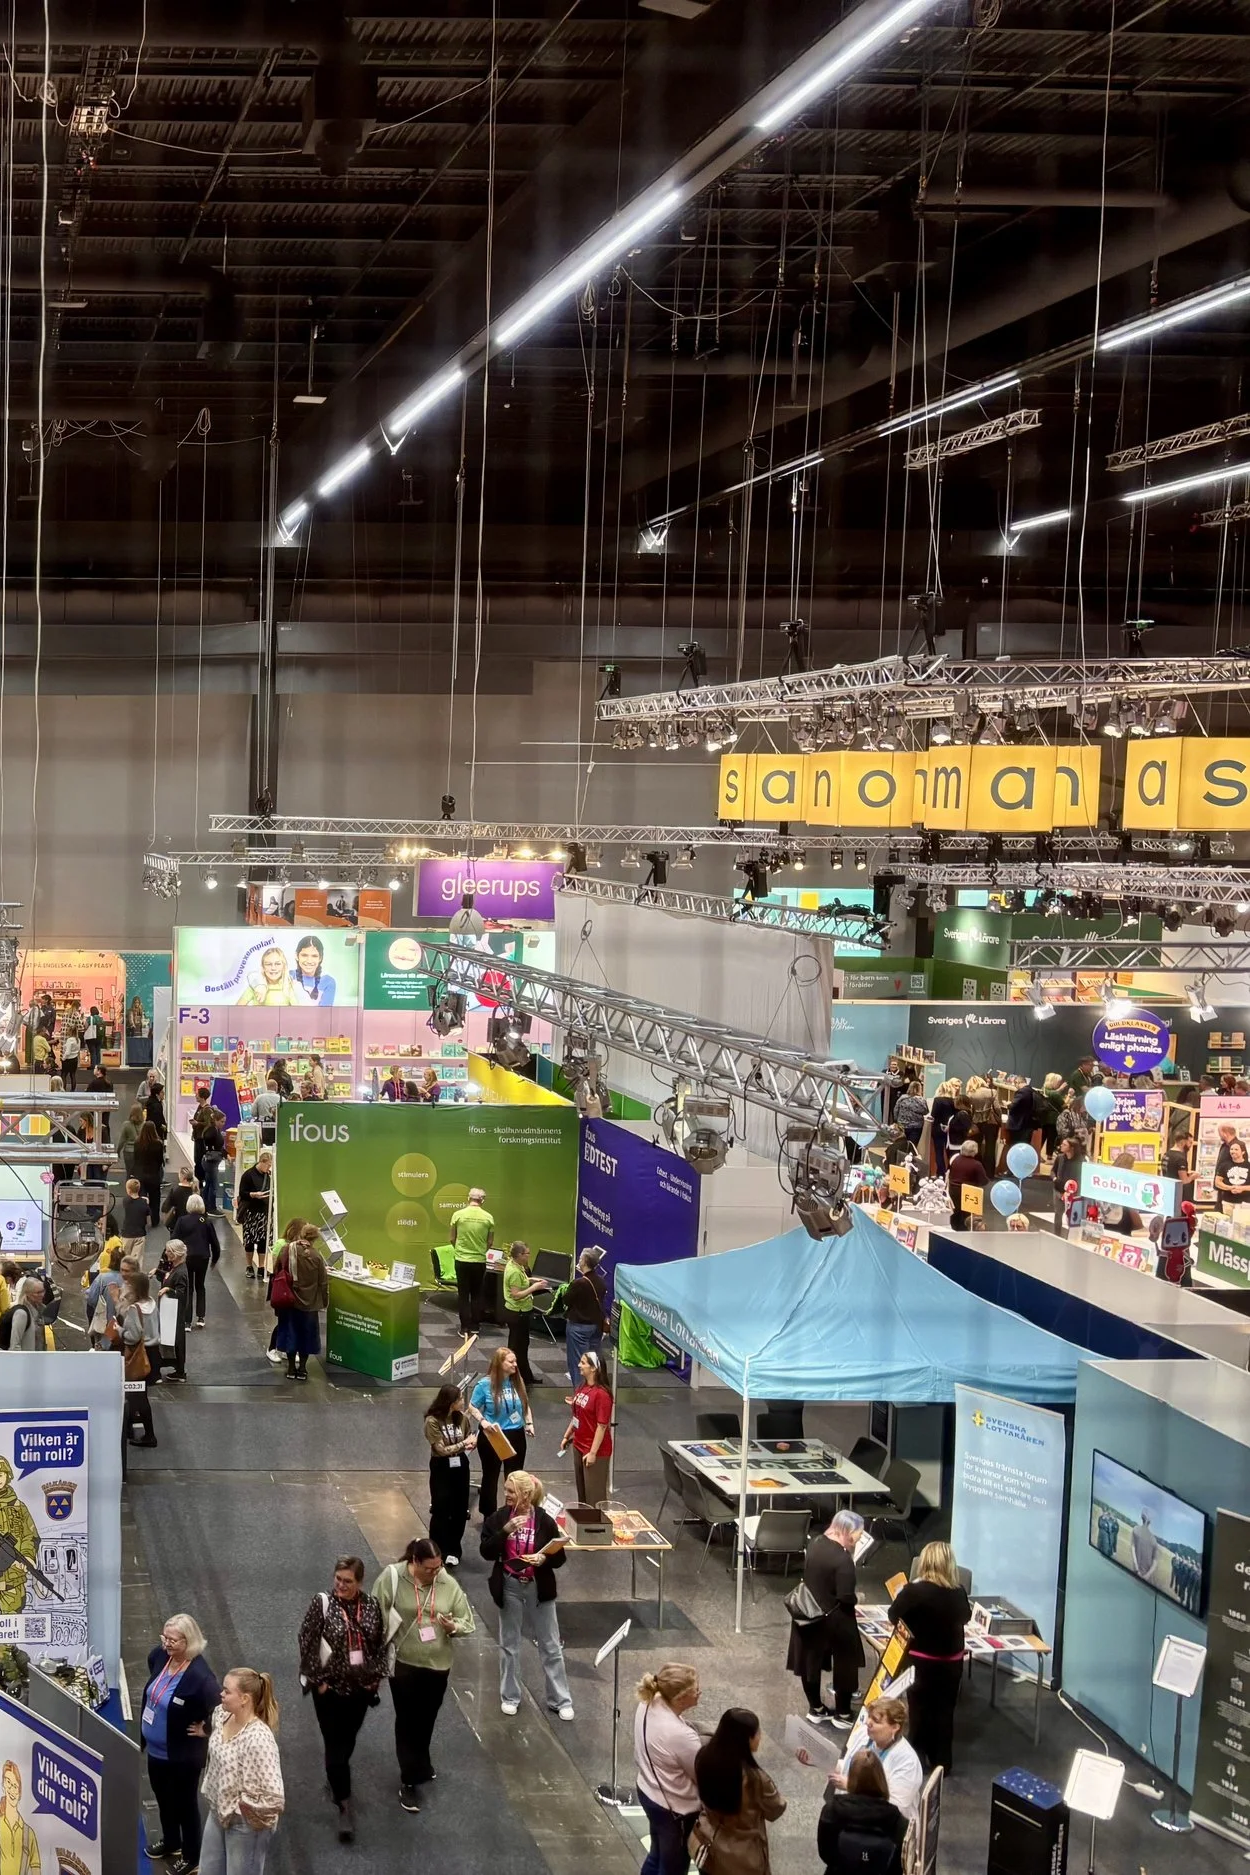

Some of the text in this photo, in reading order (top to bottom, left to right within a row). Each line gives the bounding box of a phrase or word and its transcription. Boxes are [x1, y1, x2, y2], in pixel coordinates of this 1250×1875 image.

[441, 871, 540, 903] gleerups
[943, 927, 1000, 945] Sveriges Lärare
[204, 936, 275, 993] Beställ provexemplar!
[179, 1007, 210, 1024] F-3
[927, 1015, 1006, 1027] Sveriges Lärare
[1099, 1042, 1162, 1054] enligt phonics
[1104, 1032, 1159, 1046] Läsinlärning
[1113, 1097, 1136, 1107] örjan
[289, 1113, 350, 1143] ifous
[493, 1126, 562, 1135] skolhuvudmännens
[498, 1136, 561, 1146] forskningsinstitut
[584, 1142, 618, 1177] EDTEST
[1092, 1176, 1131, 1194] Robin
[631, 1288, 668, 1327] Svenska
[986, 1416, 1027, 1434] SVENSKA
[20, 1432, 79, 1447] Vilken är
[985, 1423, 1045, 1446] LOTTAKÅREN
[20, 1447, 74, 1462] din roll?
[963, 1461, 973, 1472] för
[974, 1464, 1002, 1479] kvinnor
[1003, 1475, 1019, 1485] som
[964, 1451, 1047, 1485] Sveriges främsta forum
[37, 1752, 94, 1806] Vilken är
[37, 1777, 89, 1825] din roll?
